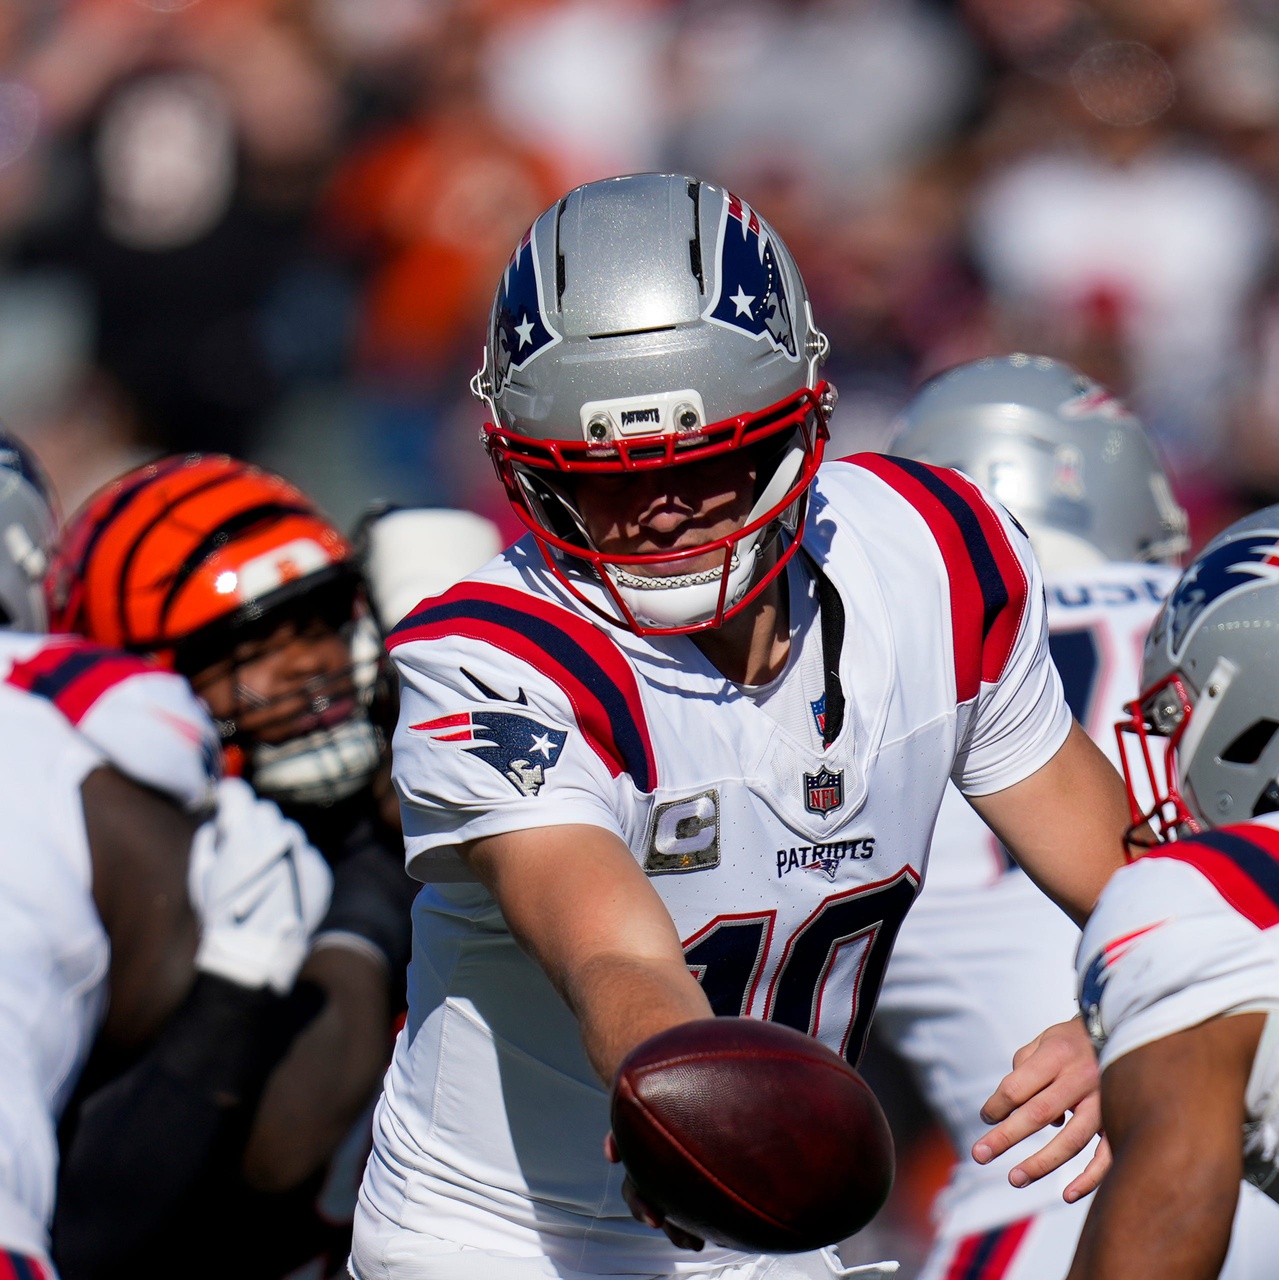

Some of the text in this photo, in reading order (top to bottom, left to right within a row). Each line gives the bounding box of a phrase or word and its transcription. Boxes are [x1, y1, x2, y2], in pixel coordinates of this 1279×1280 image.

[810, 788, 839, 809] NFL
[655, 796, 716, 855] C
[777, 837, 875, 878] PATRIOTS
